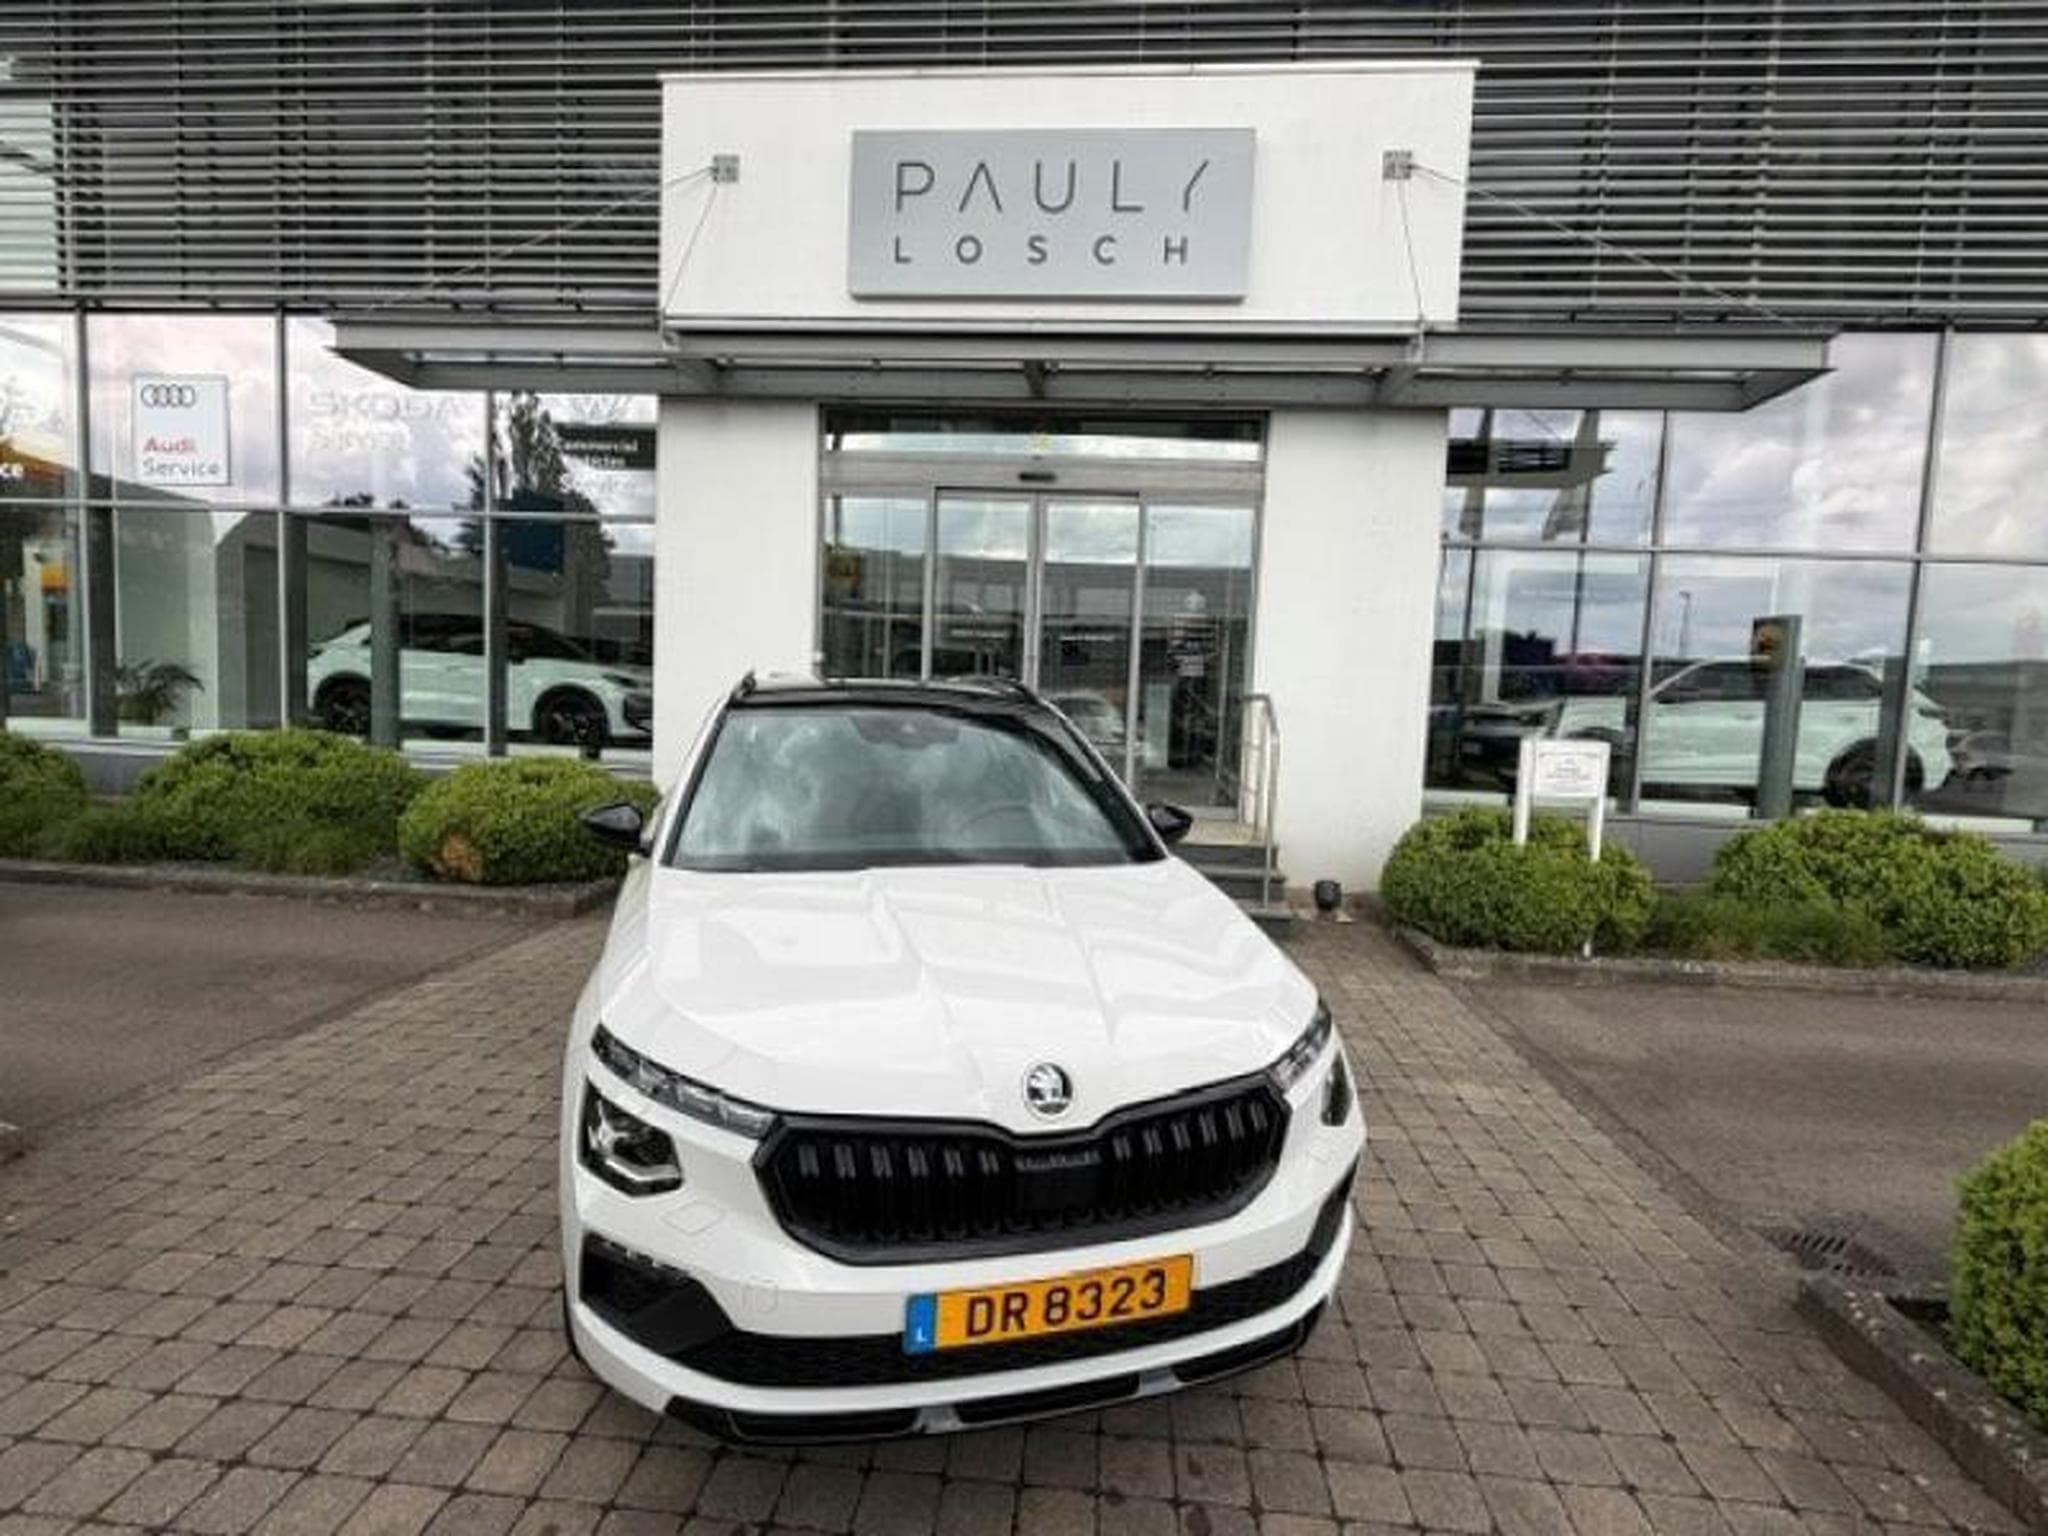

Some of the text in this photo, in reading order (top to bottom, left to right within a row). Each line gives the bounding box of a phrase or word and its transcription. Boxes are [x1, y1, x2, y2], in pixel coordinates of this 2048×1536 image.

[895, 159, 1210, 214] PAULY
[894, 234, 1189, 266] LOSCH
[143, 437, 198, 453] Audi
[142, 458, 220, 476] Service
[965, 1267, 1167, 1338] DR 8323
[915, 1327, 928, 1343] L
